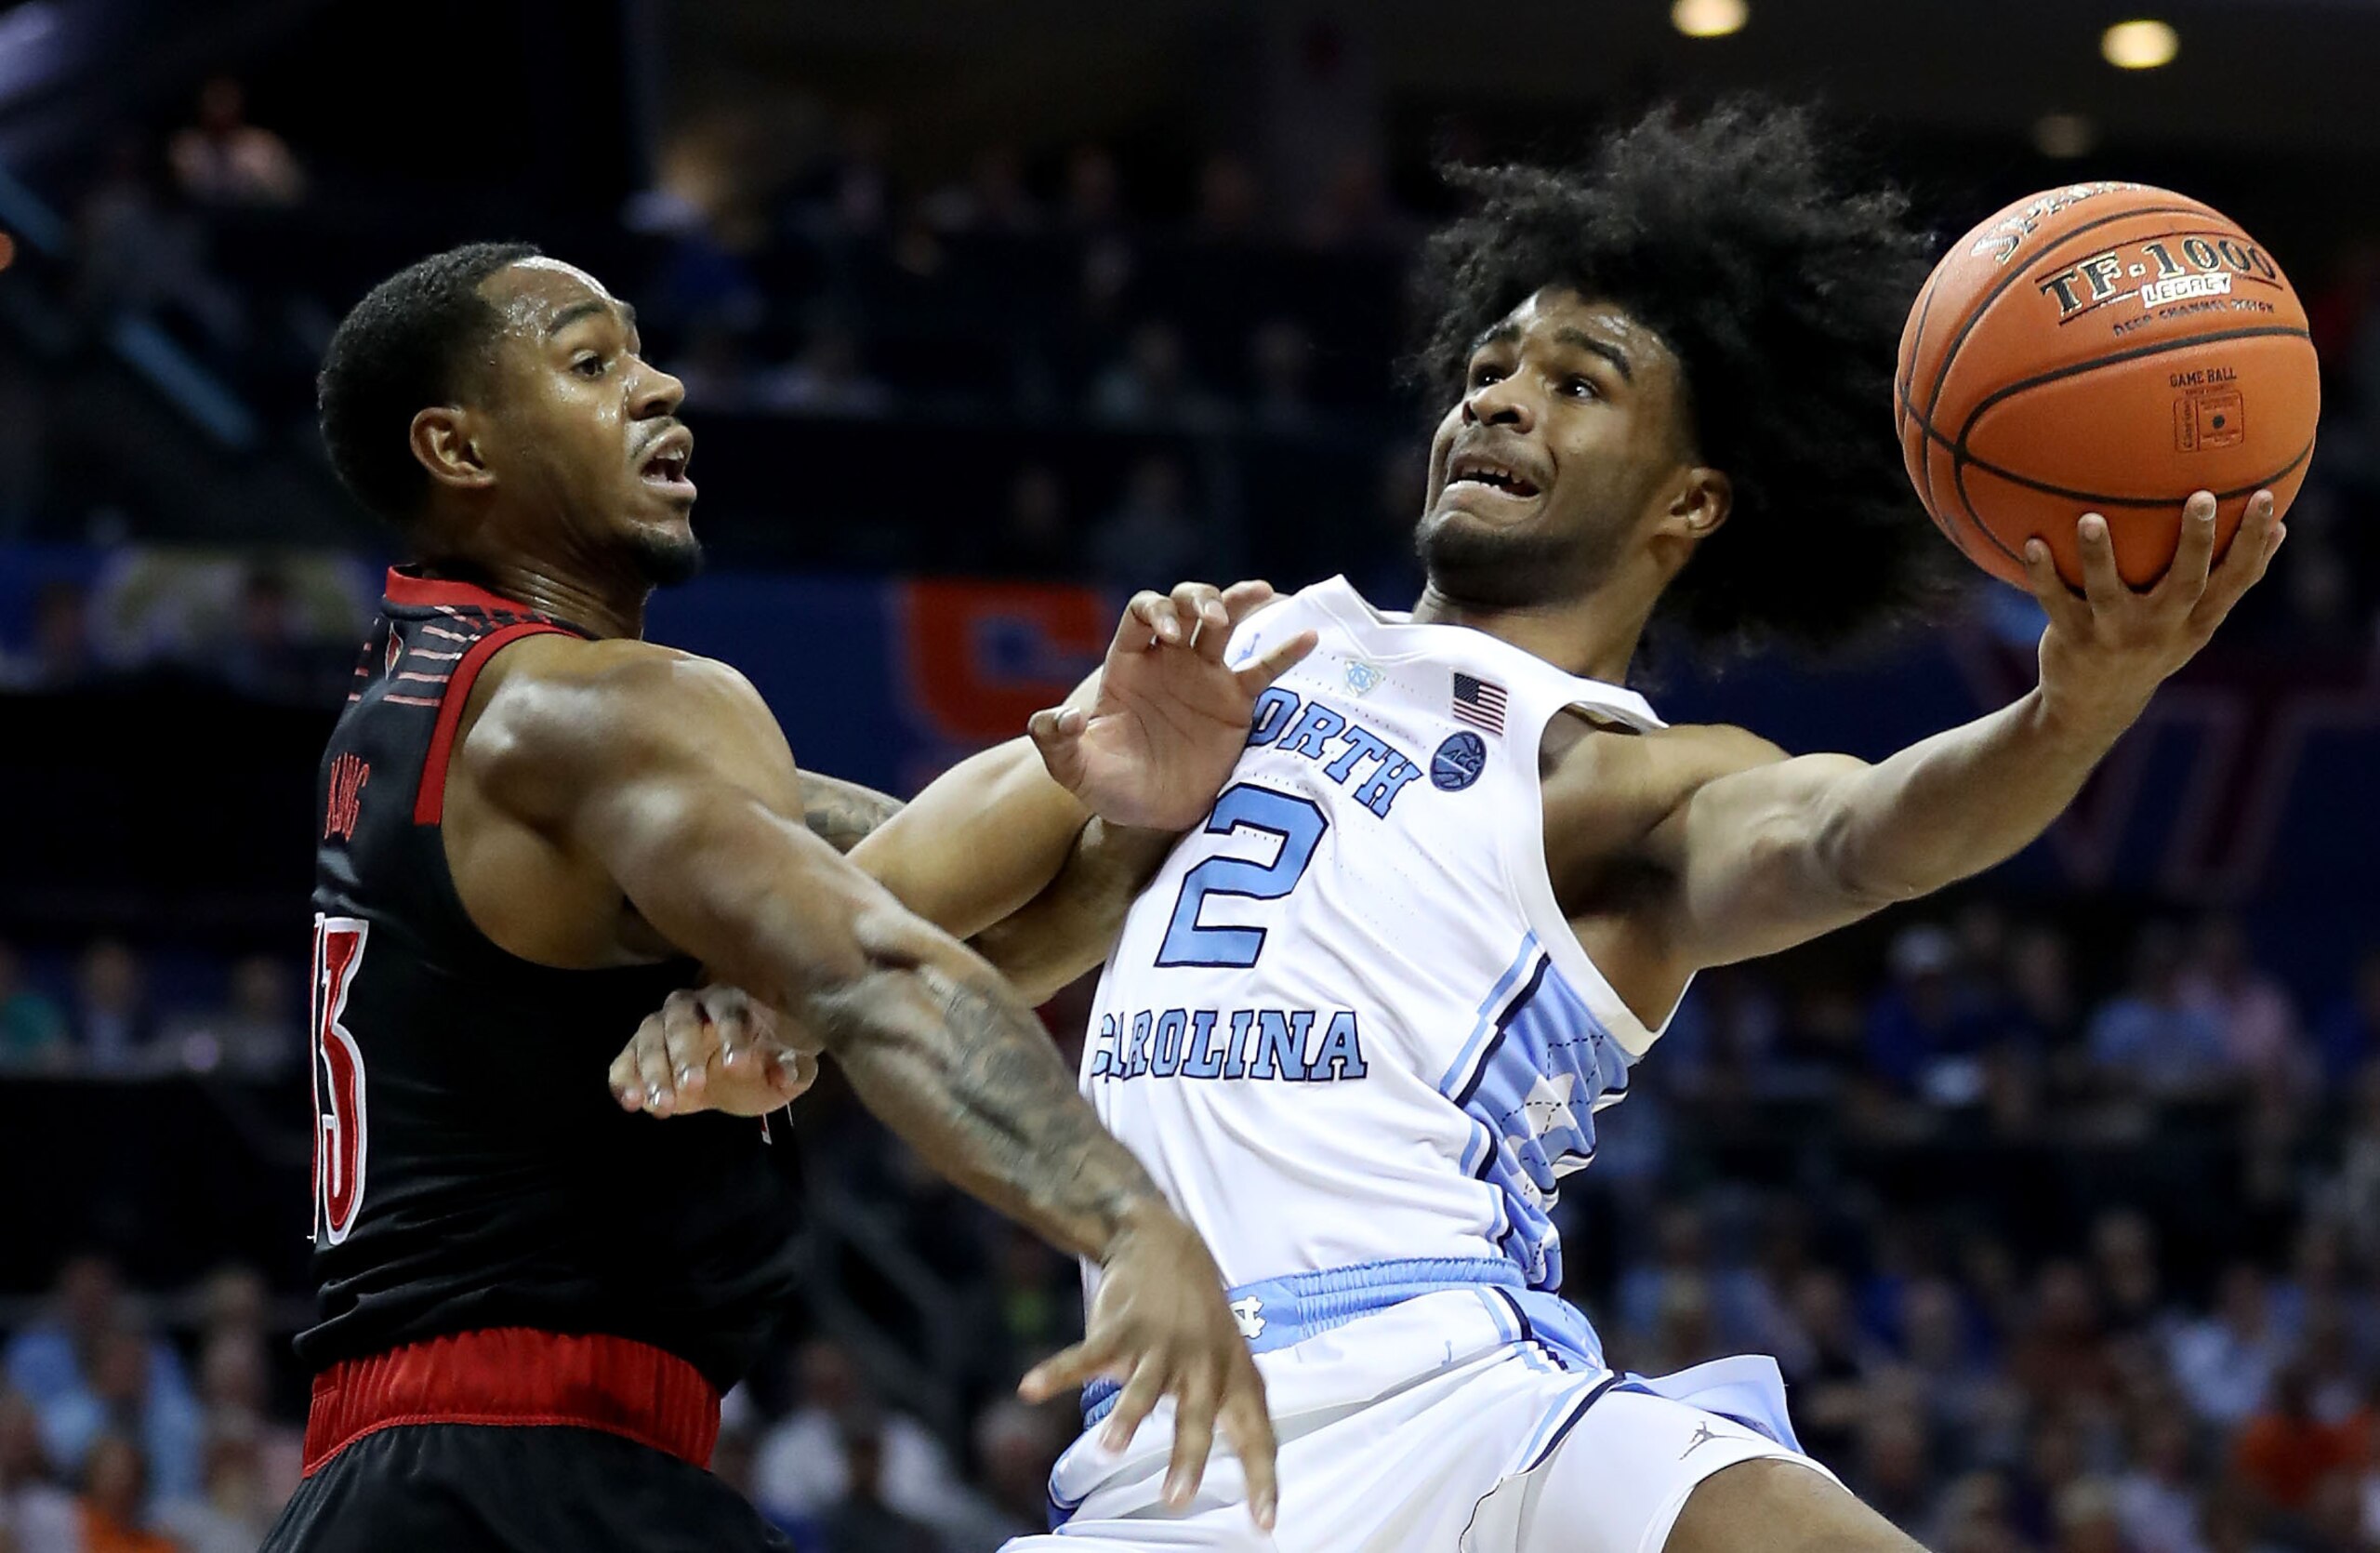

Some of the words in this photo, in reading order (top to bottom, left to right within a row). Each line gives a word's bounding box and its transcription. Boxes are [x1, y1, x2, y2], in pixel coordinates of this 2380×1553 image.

[2143, 273, 2229, 306] LEGACY
[2112, 313, 2152, 337] DEEP
[2169, 371, 2204, 388] GAME
[2207, 367, 2237, 383] BALL
[1243, 686, 1425, 821] ORTH
[1154, 782, 1329, 969] 2
